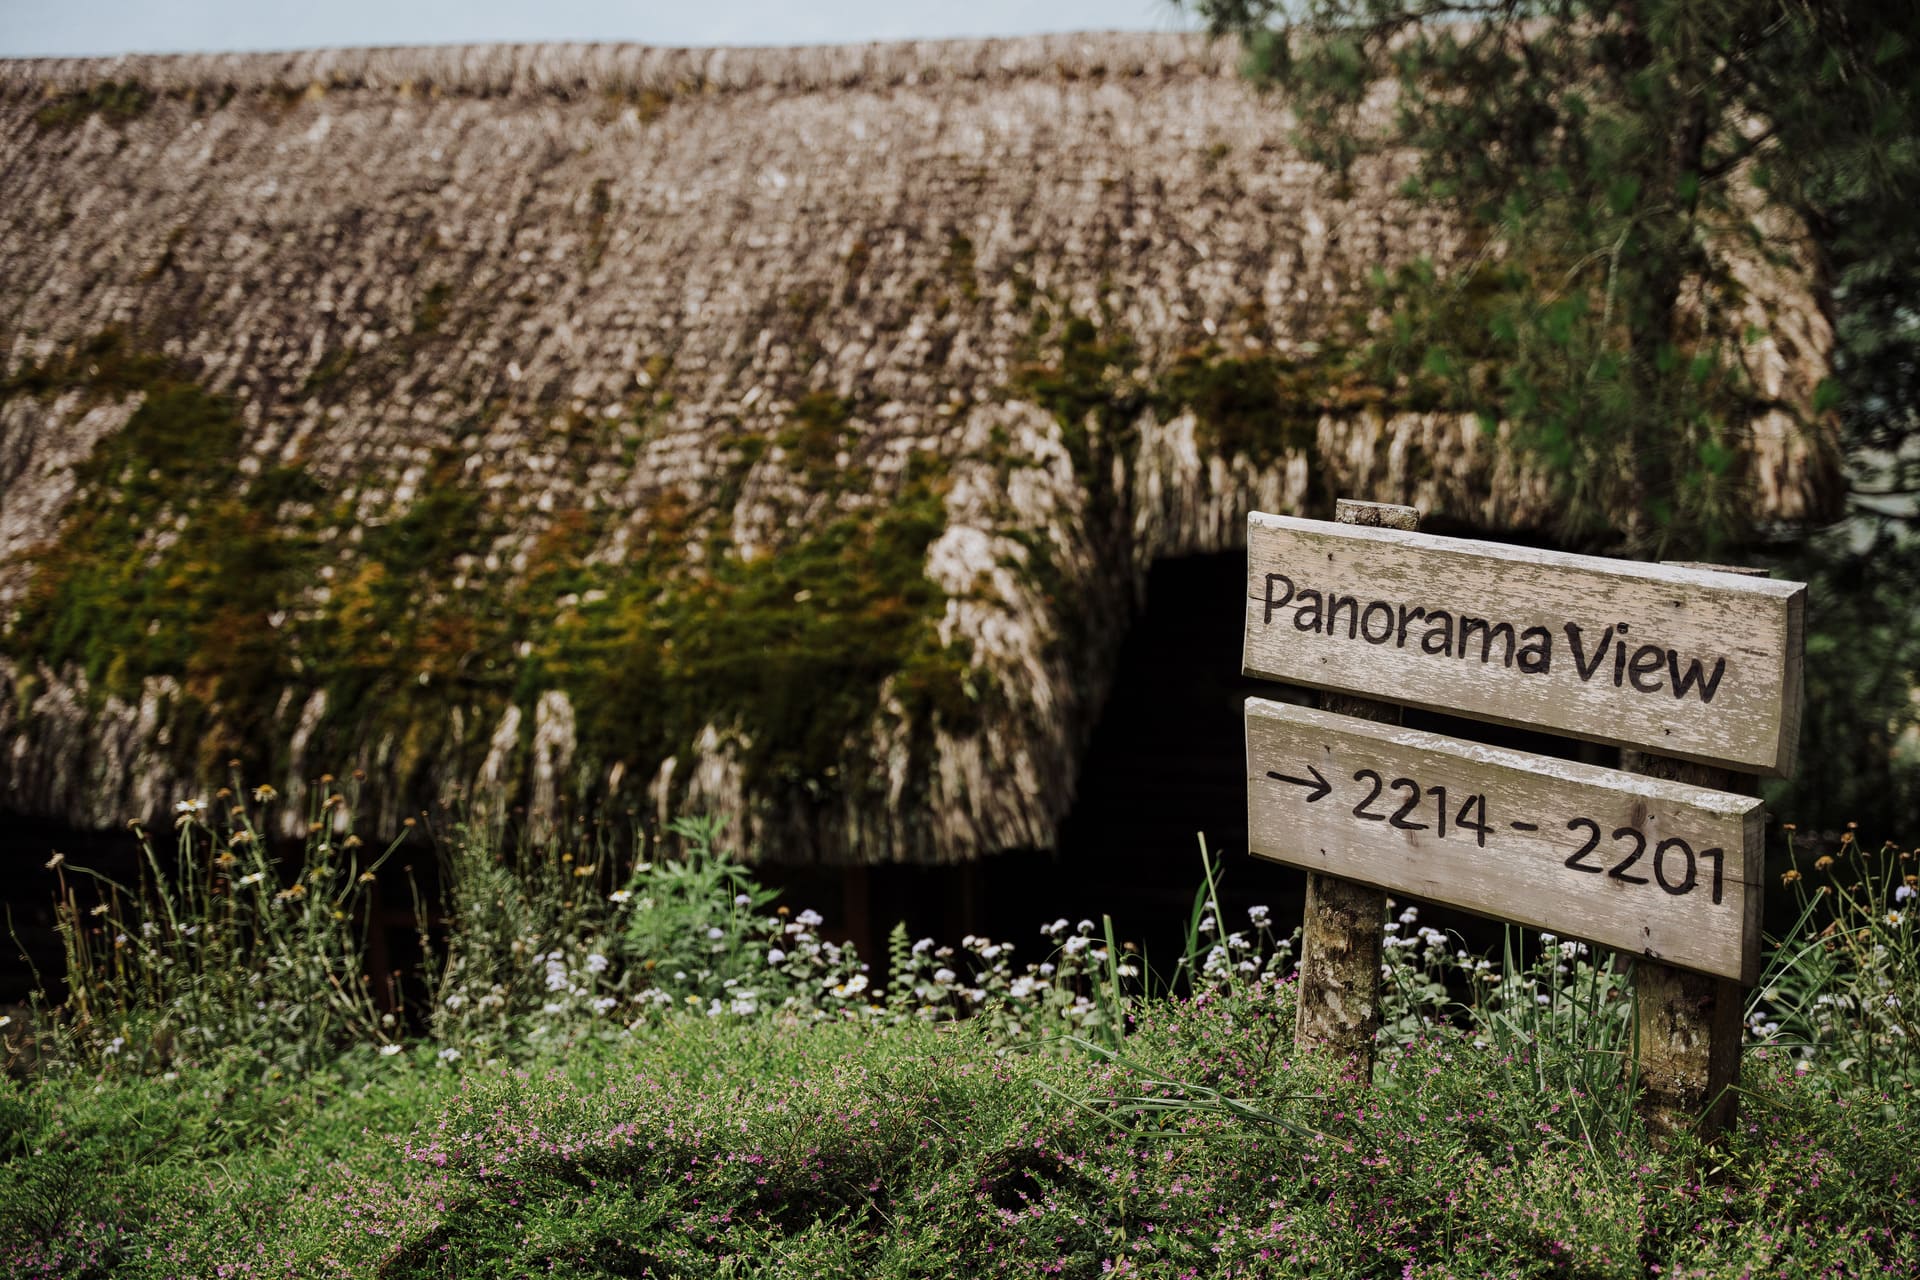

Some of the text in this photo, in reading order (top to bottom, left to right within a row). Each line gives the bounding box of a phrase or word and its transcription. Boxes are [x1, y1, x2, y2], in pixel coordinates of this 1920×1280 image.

[1264, 572, 1726, 704] Panorama View
[1352, 769, 1725, 905] 2214 - 2201
